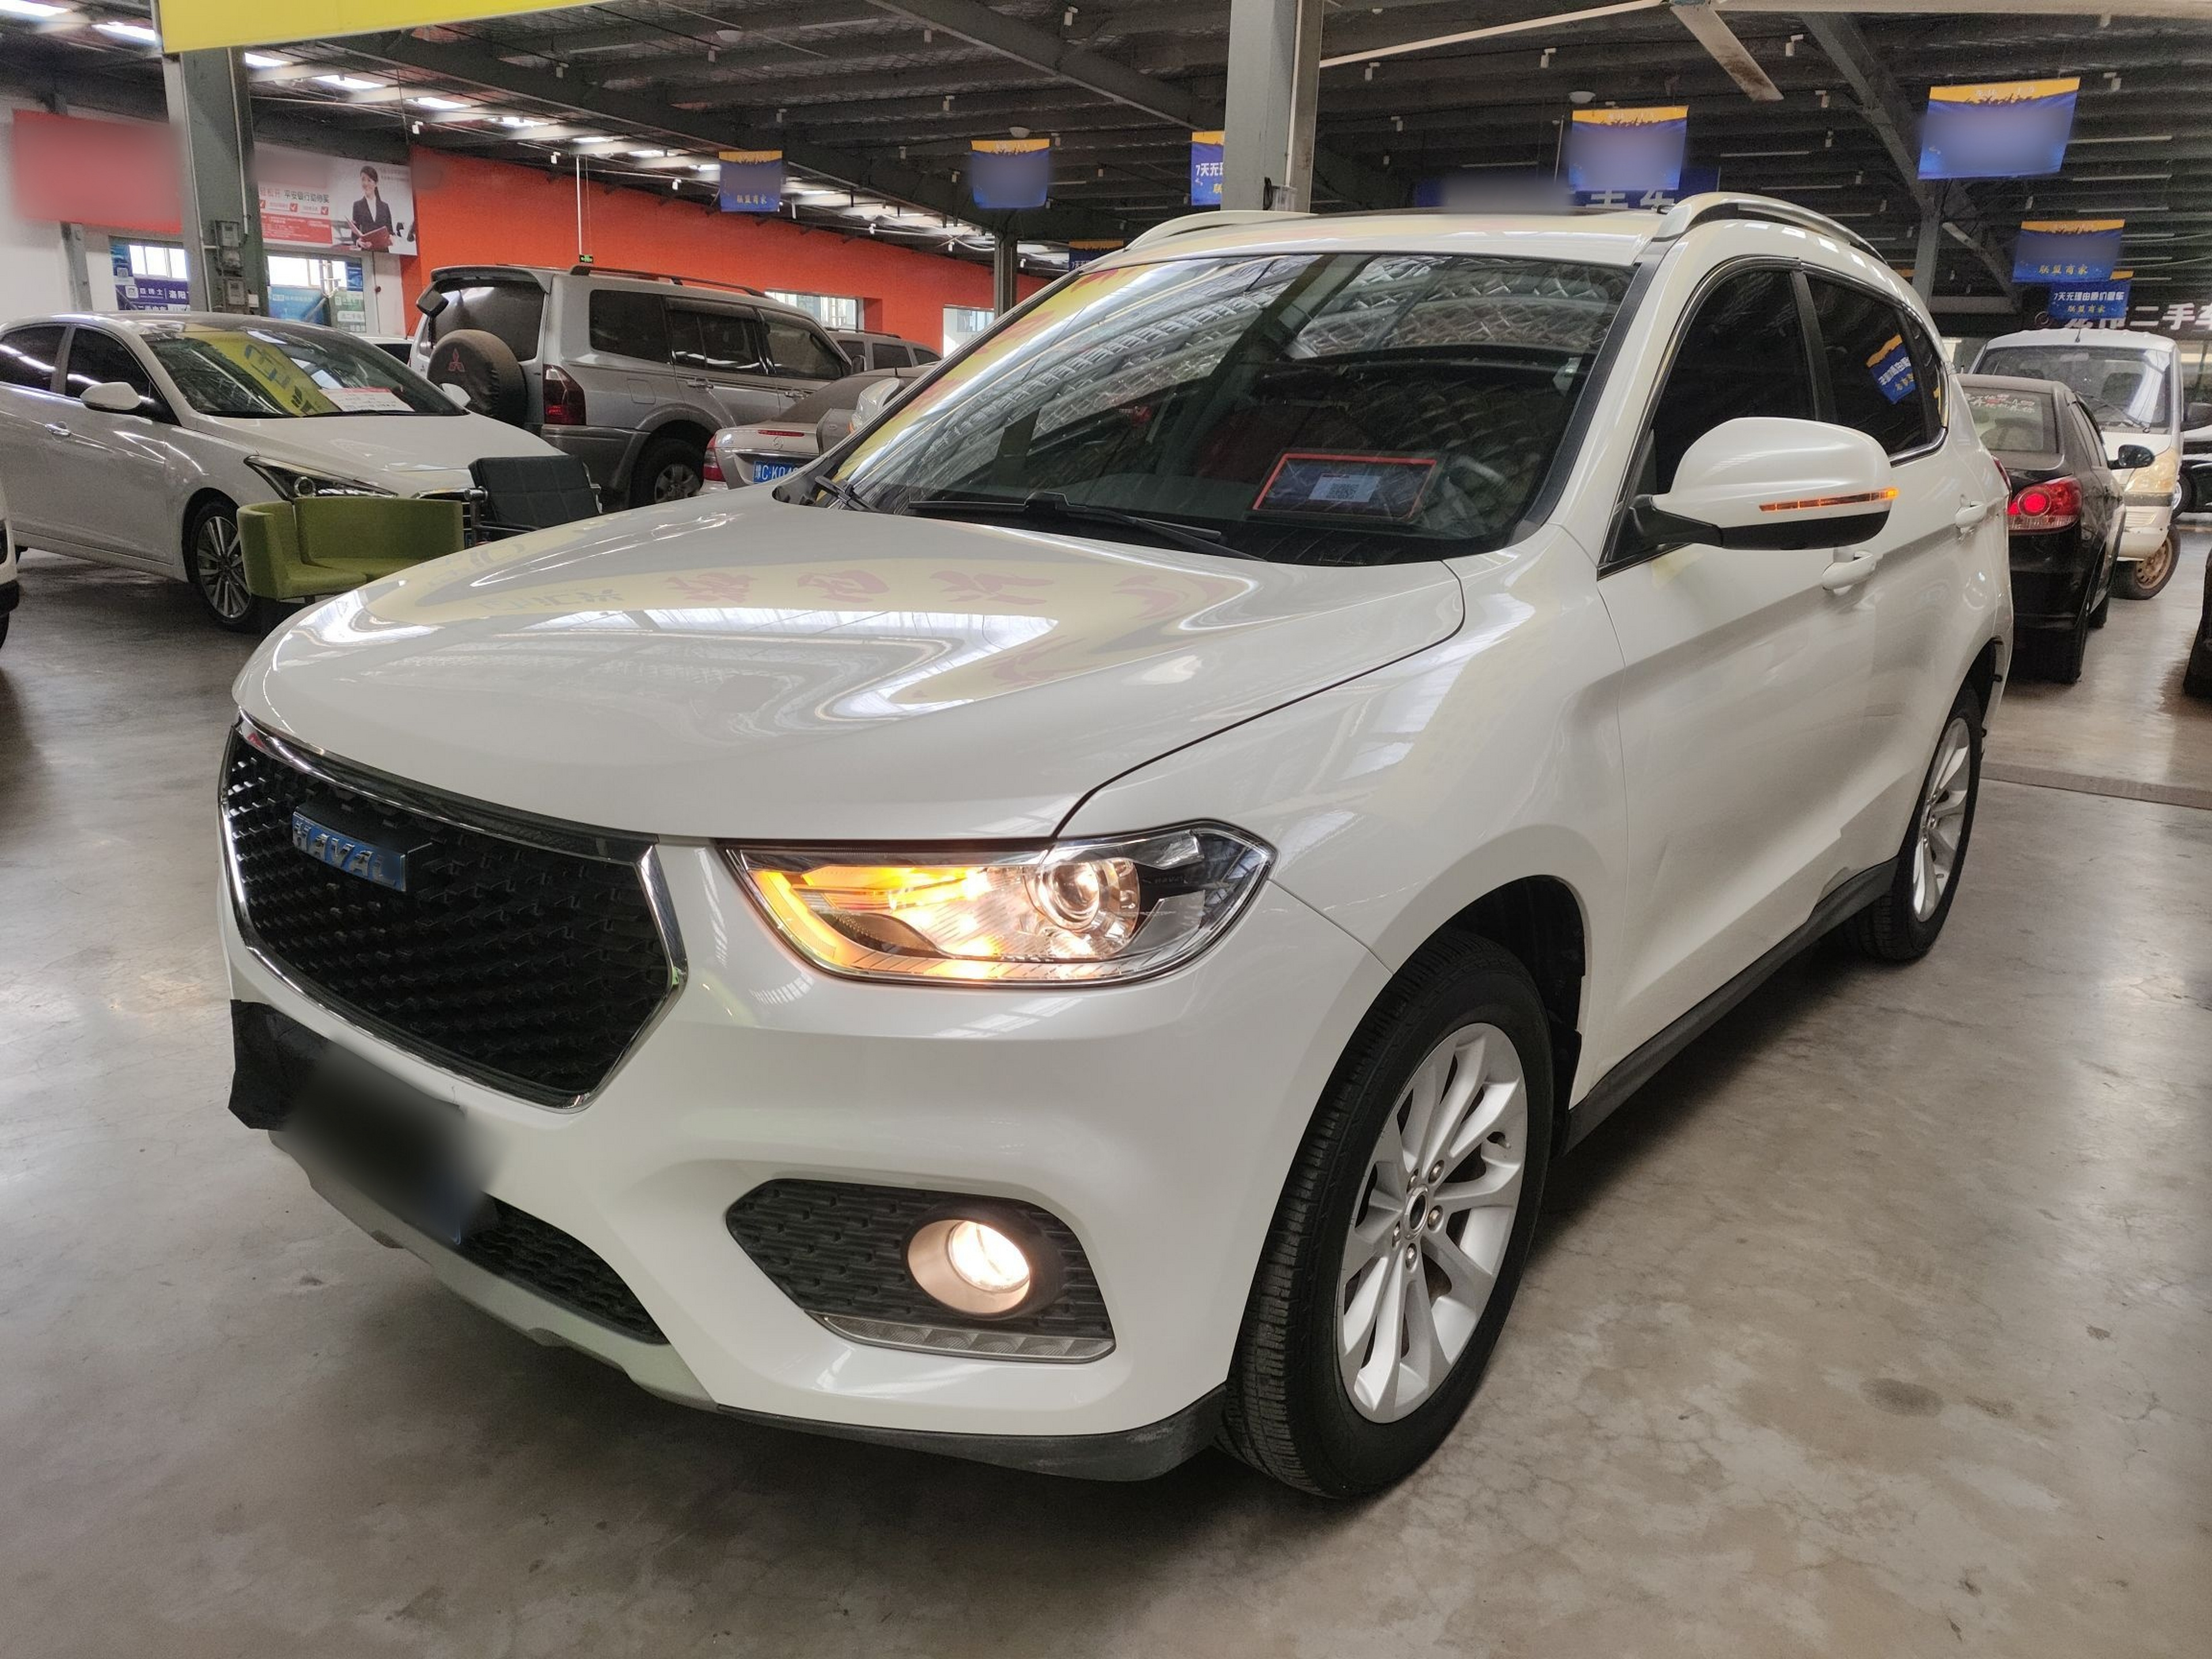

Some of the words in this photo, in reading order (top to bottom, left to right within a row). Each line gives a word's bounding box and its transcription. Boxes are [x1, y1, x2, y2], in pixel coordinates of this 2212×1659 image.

[2039, 264, 2088, 274] 联盟商家
[169, 290, 189, 299] 洛阳
